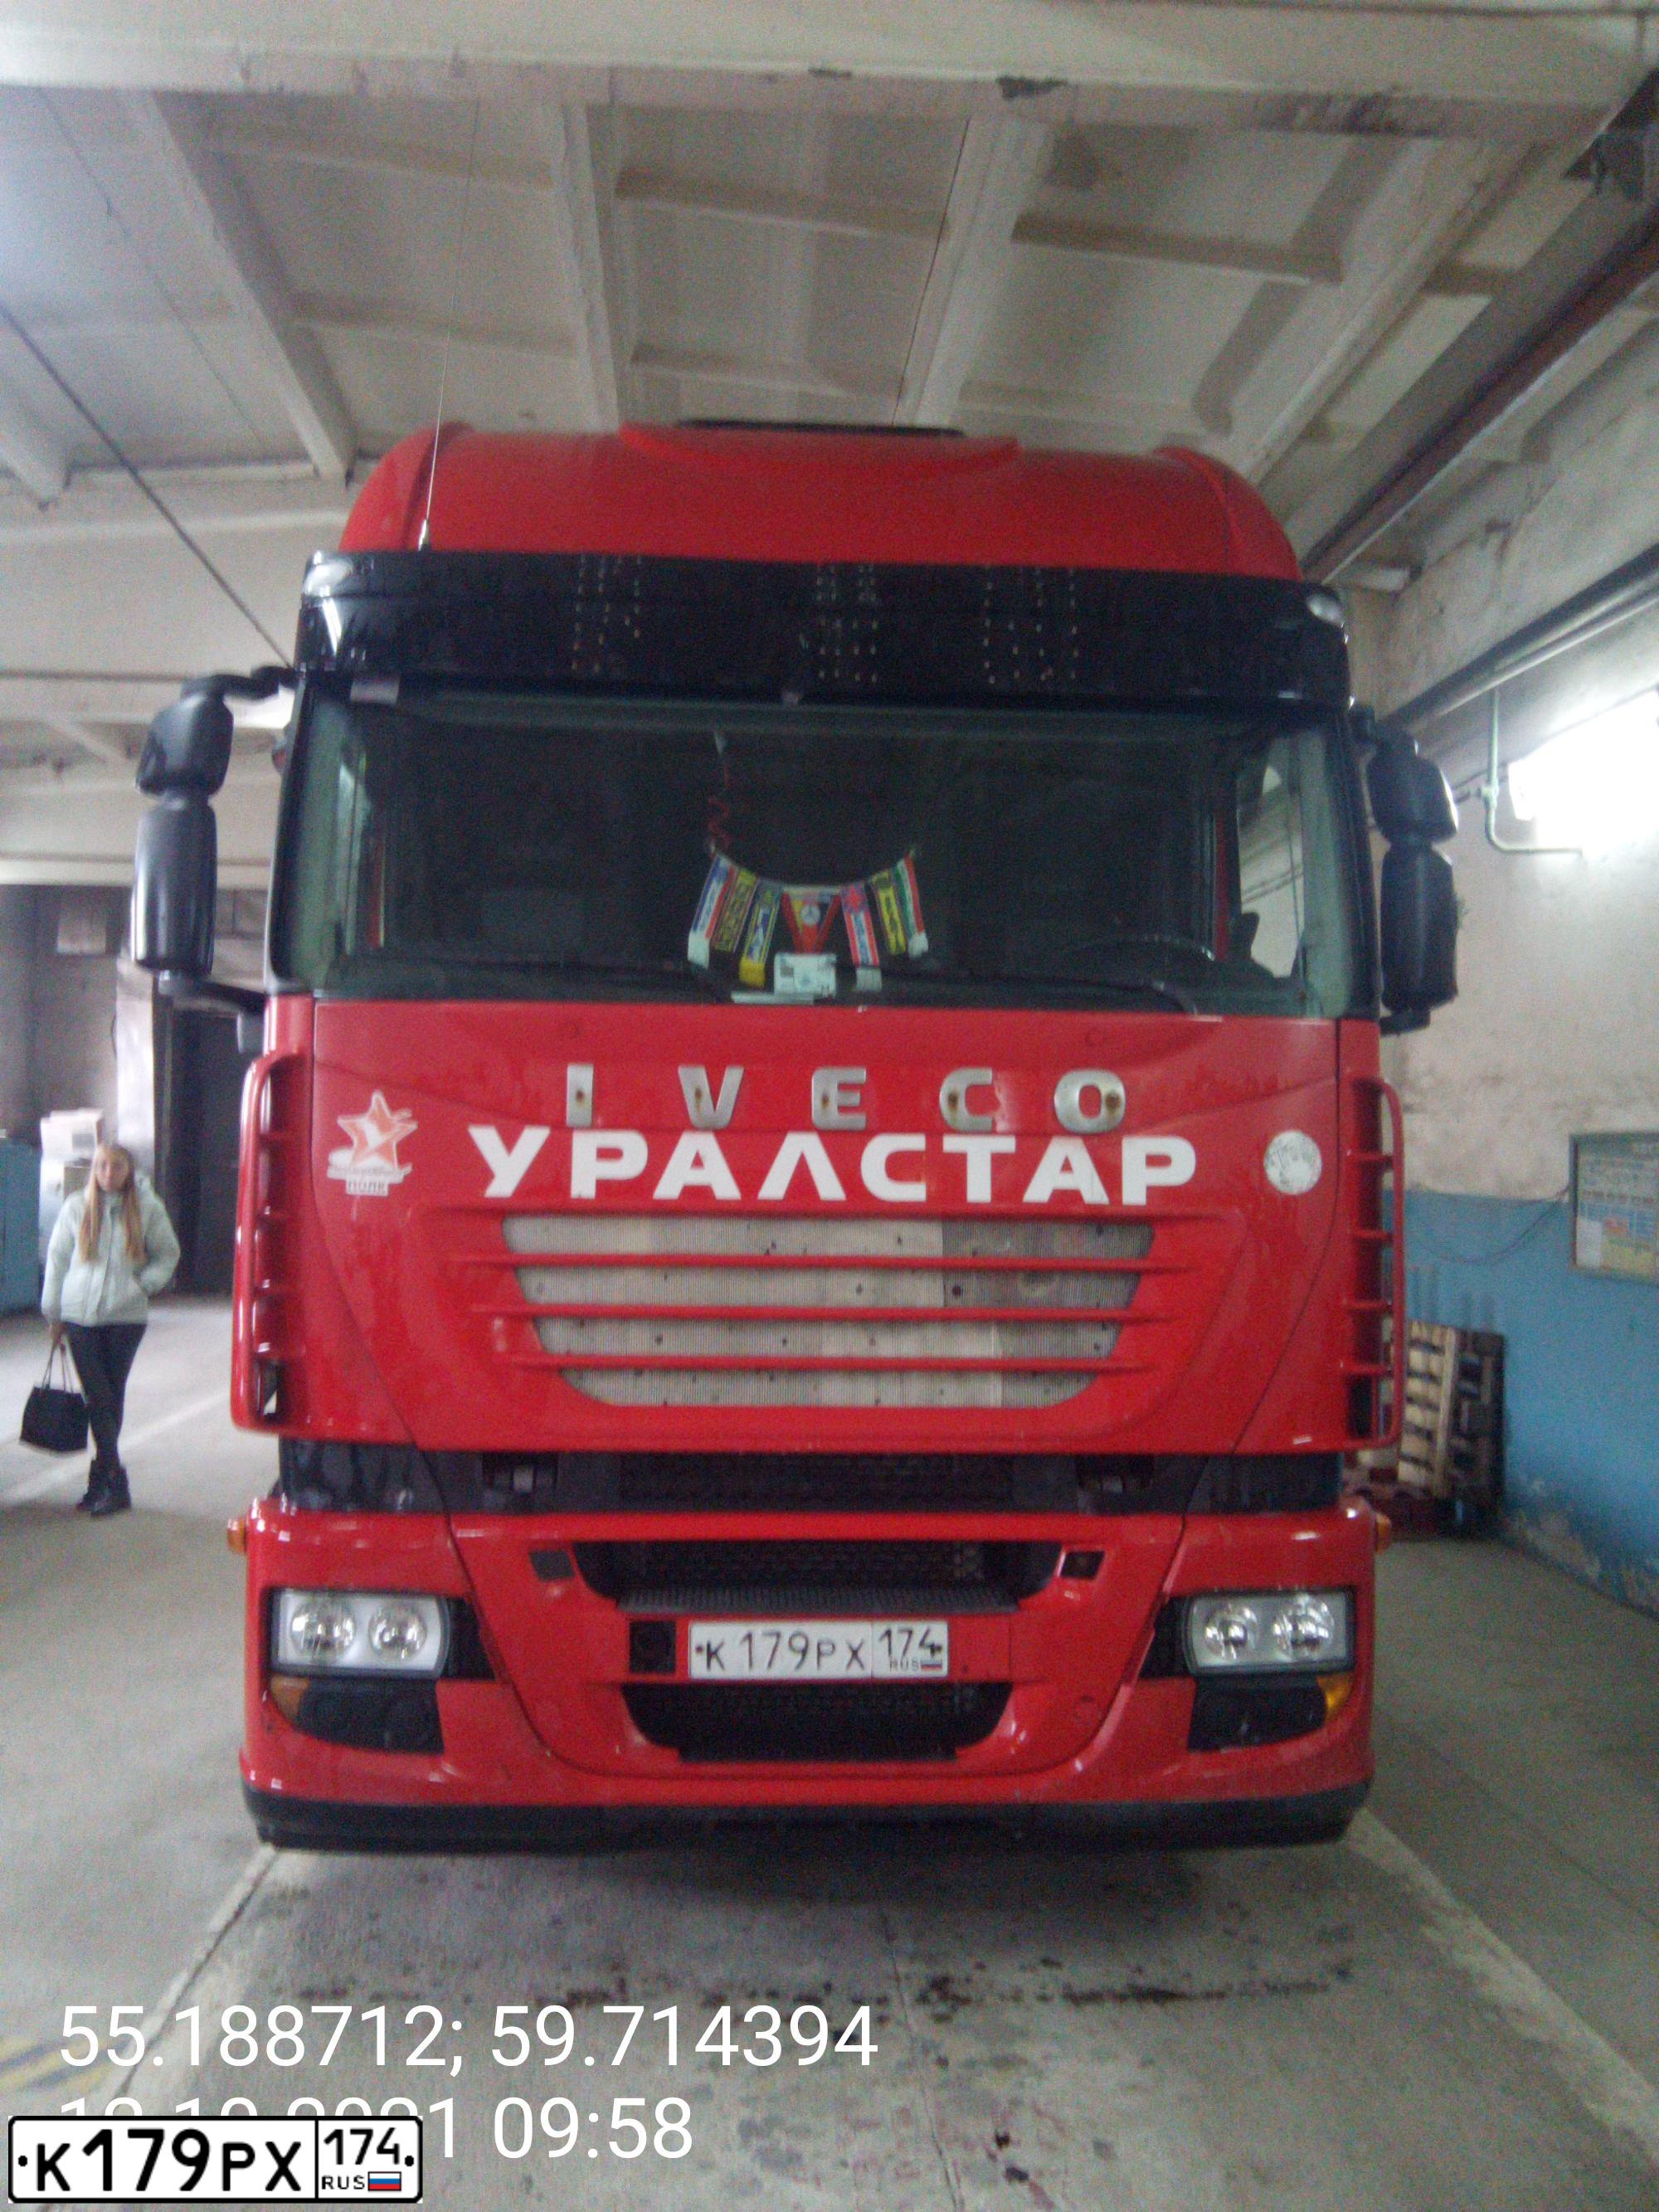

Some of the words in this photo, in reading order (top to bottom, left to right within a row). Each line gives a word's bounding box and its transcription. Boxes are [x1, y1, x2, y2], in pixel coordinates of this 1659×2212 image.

[566, 1064, 1126, 1135] IVECO
[467, 1124, 1197, 1206] УРАЛСТАР
[878, 1625, 937, 1659] 174
[889, 1659, 919, 1672] RUS
